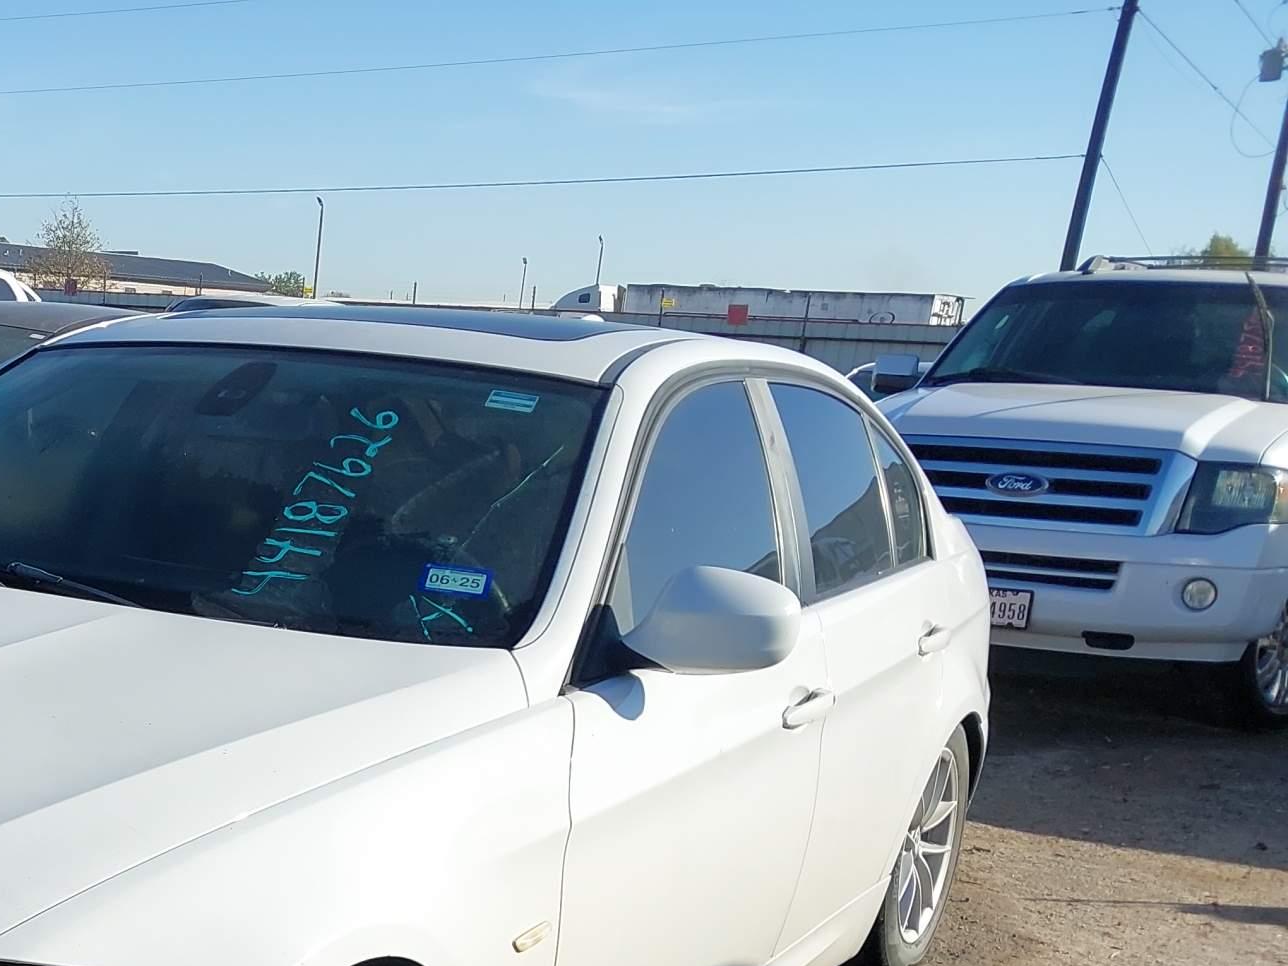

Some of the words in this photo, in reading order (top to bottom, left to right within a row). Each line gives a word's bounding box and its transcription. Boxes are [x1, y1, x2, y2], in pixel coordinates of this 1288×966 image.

[997, 474, 1033, 491] Ford
[232, 407, 399, 596] 44187626
[429, 573, 450, 585] 06
[458, 577, 481, 589] 25
